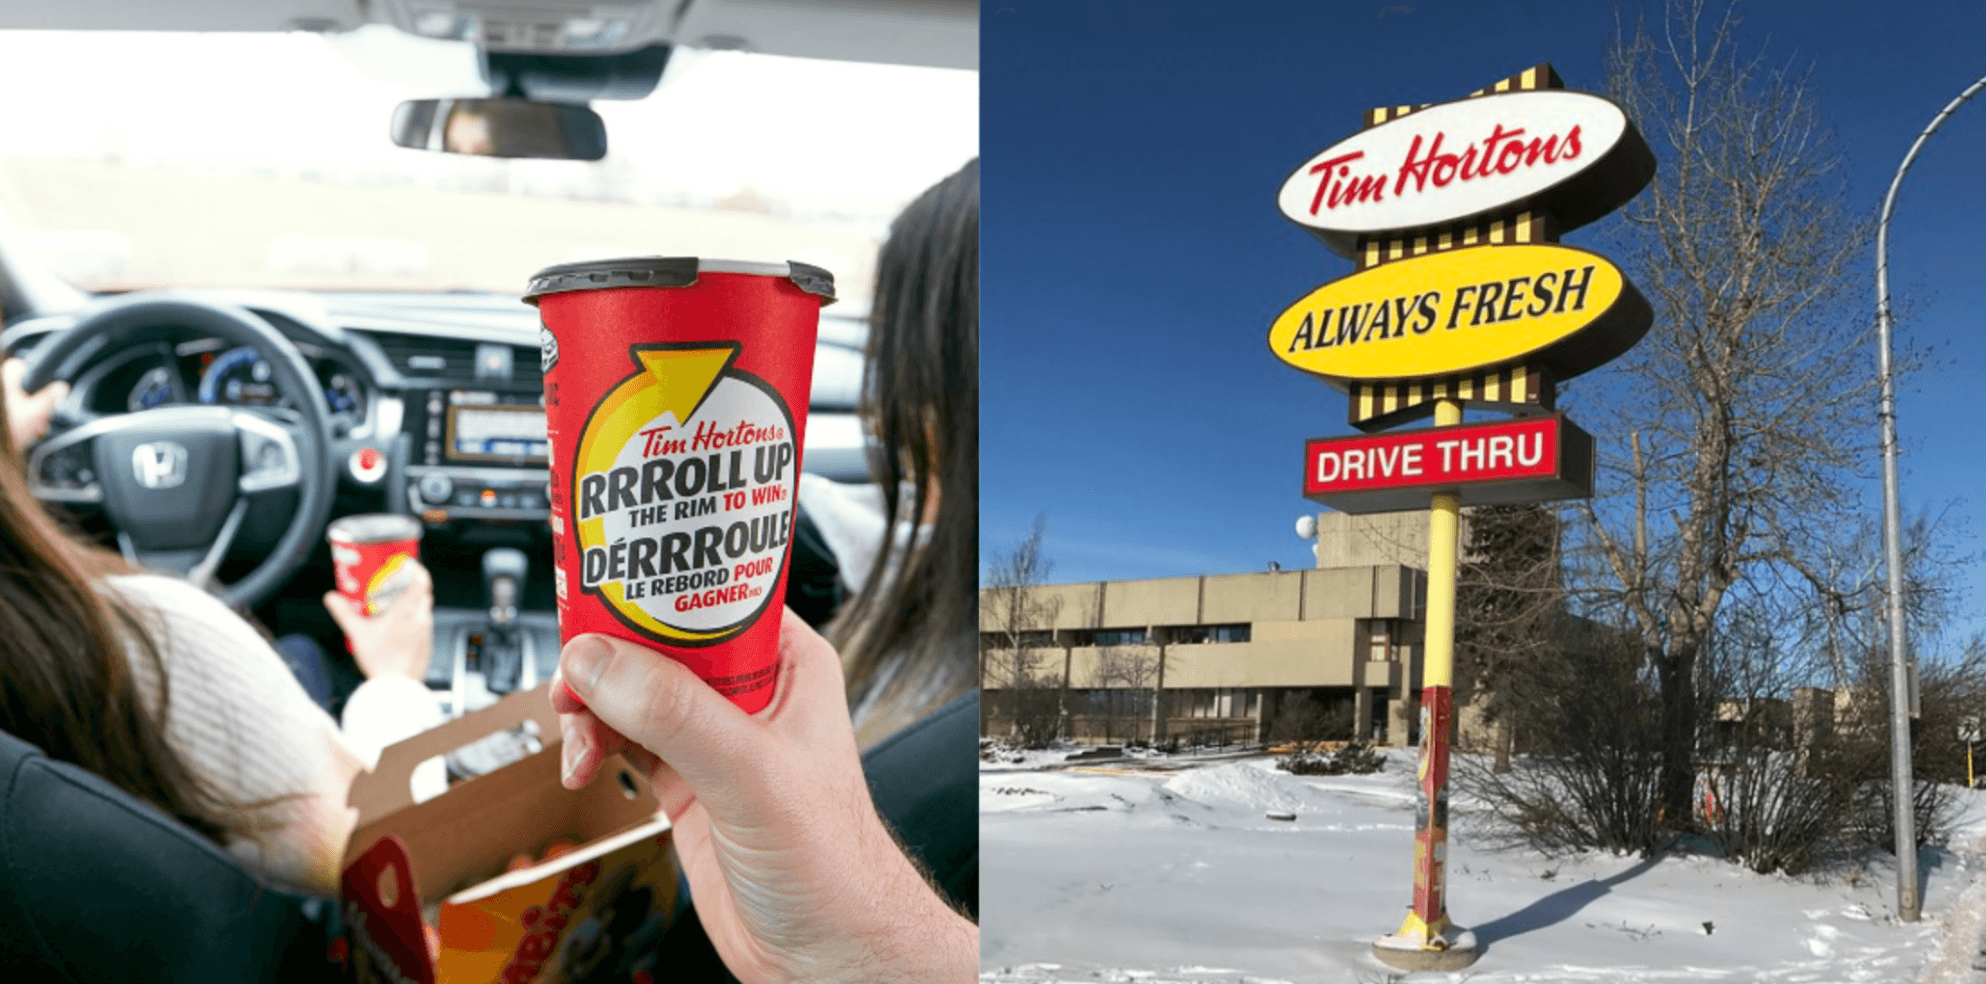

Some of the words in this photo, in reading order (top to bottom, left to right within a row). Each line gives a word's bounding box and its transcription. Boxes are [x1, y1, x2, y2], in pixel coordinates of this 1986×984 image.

[1308, 149, 1388, 216] Tim
[1394, 124, 1583, 197] Hortons
[1288, 291, 1440, 353] ALWAYS
[1446, 266, 1595, 329] FRESH
[639, 426, 686, 458] Tim
[1317, 444, 1424, 483] DRIVE
[1436, 432, 1544, 473] THRU
[581, 450, 747, 519] RRROLL
[754, 442, 792, 484] UP
[629, 505, 668, 528] THE
[674, 496, 717, 520] RIM
[723, 491, 747, 512] TO
[586, 510, 789, 583] DÉRRROULE
[626, 581, 646, 600] LE
[651, 568, 730, 596] REBORD
[734, 556, 773, 581] POUR
[674, 583, 749, 612] GAGNER
